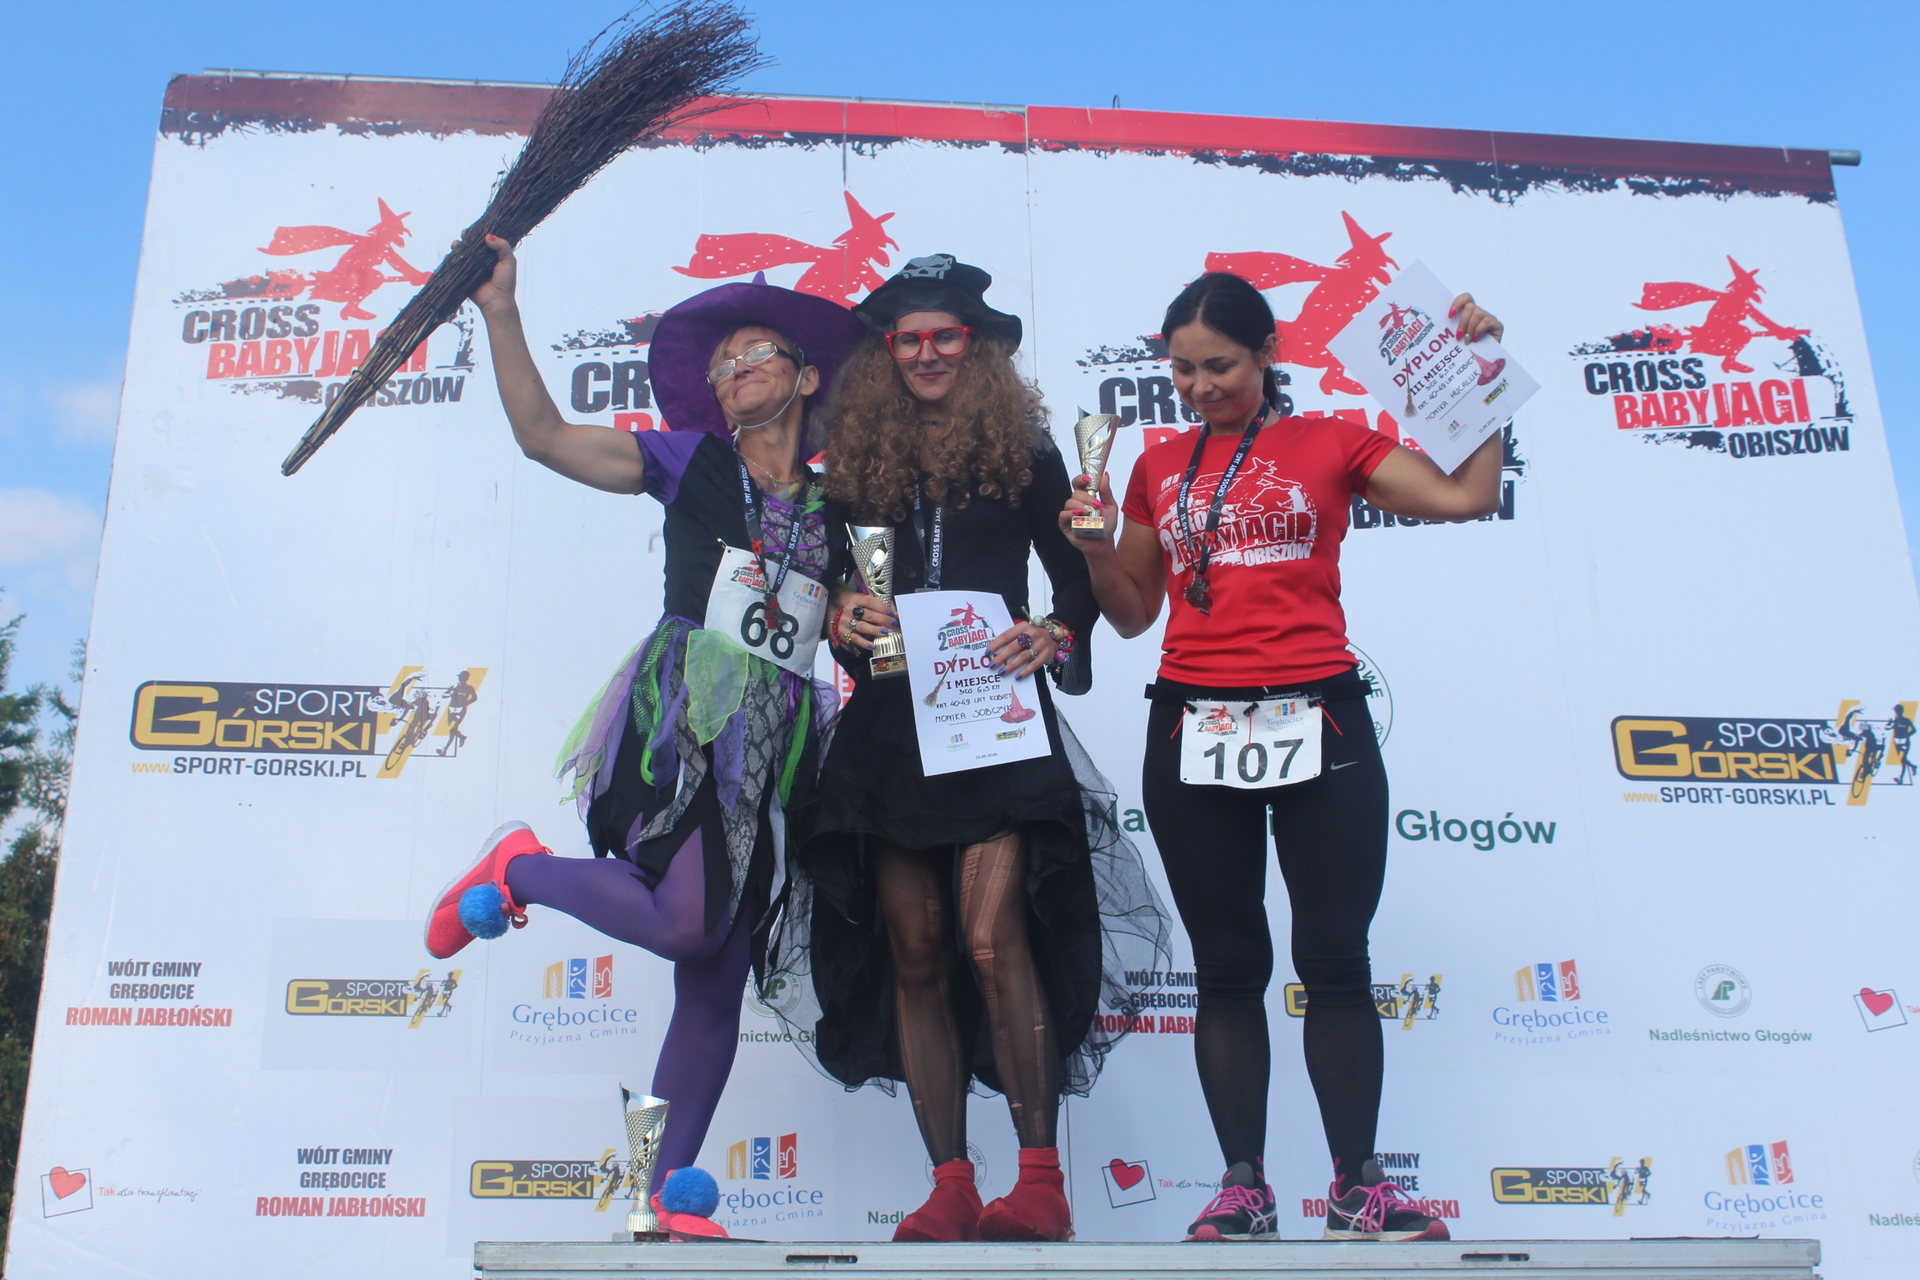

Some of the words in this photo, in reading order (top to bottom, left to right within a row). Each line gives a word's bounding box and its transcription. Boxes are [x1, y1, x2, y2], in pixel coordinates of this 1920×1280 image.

[182, 304, 321, 344] CROSS
[206, 328, 428, 379] BABYJAI
[1380, 347, 1397, 366] 2
[1392, 327, 1456, 388] DYPLOM
[1410, 381, 1425, 397] III
[1423, 344, 1463, 383] MIEJSCE
[1584, 358, 1706, 395] CROSS
[1613, 378, 1811, 430] BABYJAGI
[1728, 423, 1850, 459] OBISZÓW
[1216, 478, 1230, 497] CROSS
[1228, 464, 1238, 479] BABY
[933, 524, 941, 543] BABY
[931, 544, 940, 567] CROSS
[1159, 528, 1186, 576] 2
[1243, 541, 1313, 567] OBISZÓW
[730, 569, 741, 582] 2
[740, 601, 799, 660] 68
[937, 631, 949, 652] 2
[946, 625, 969, 638] CROSS
[933, 655, 1007, 675] DYPLO
[946, 681, 952, 690] I
[955, 674, 1001, 689] MIEJSCE
[253, 688, 370, 717] SPORT
[134, 684, 371, 751] GÓRSKI
[1197, 721, 1205, 733] 2
[1718, 722, 1821, 749] SPORT
[1614, 718, 1834, 780] GÓRSKI
[131, 756, 367, 778] www.SPORT-GORSKI.PL
[1203, 738, 1304, 783] 107
[1623, 785, 1836, 806] www.SPORT-GORSKI.PL
[1395, 809, 1557, 852] Głogów
[108, 958, 150, 977] WÓJT
[152, 961, 202, 978] GMINY
[1124, 968, 1163, 987] WÓJT
[1166, 971, 1199, 988] GMI
[110, 983, 194, 1002] GRĘBOCICE
[288, 980, 405, 1015] GÓRSKI
[346, 982, 404, 997] SPORT
[66, 1006, 133, 1026] ROMAN
[135, 1004, 233, 1027] JABŁOŃSKI
[512, 1003, 637, 1031] Grębocice
[1094, 1014, 1156, 1034] ROMAN
[1492, 1006, 1609, 1033] Grębocice
[510, 1030, 582, 1046] Przyjazna
[590, 1026, 637, 1039] Gmina
[1494, 1031, 1562, 1047] Przyjazna
[1567, 1027, 1611, 1040] Gmina
[1649, 1028, 1751, 1042] Nadleśnictwo
[1754, 1029, 1813, 1045] Głogów
[297, 1145, 340, 1165] WÓJT
[342, 1148, 394, 1165] GMINY
[1374, 1152, 1420, 1169] GMINY
[300, 1171, 387, 1191] GRĘBOCICE
[471, 1161, 592, 1198] GÓRSKI
[531, 1163, 591, 1179] SPORT
[1546, 1169, 1601, 1185] SPORT
[98, 1187, 116, 1197] Tak
[1157, 1178, 1174, 1188] Tak
[1492, 1168, 1606, 1203] GÓRSKI
[256, 1196, 324, 1217] ROMAN
[326, 1193, 427, 1218] JABŁOŃSKI
[718, 1185, 823, 1214] rębocice
[1704, 1190, 1824, 1218] Grębocice
[775, 1209, 824, 1222] Gmina
[1706, 1217, 1776, 1233] Przyjazna
[1782, 1212, 1827, 1226] Gmina
